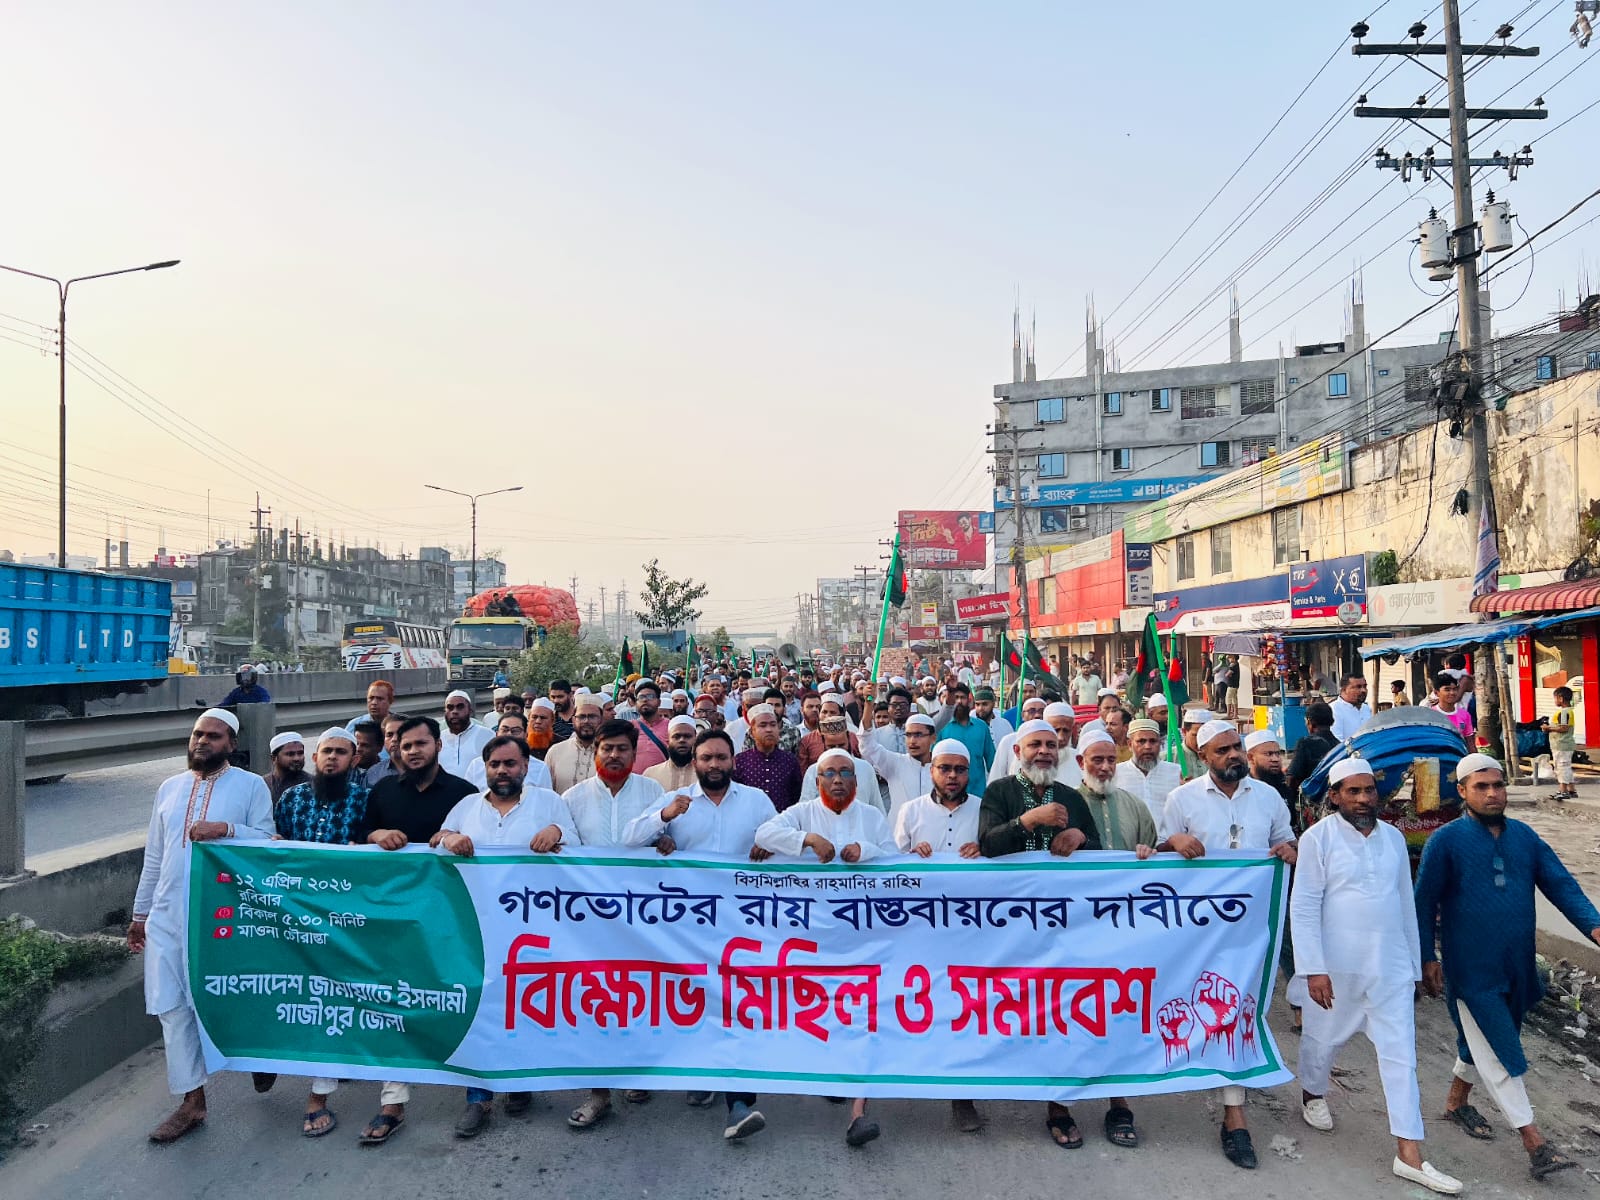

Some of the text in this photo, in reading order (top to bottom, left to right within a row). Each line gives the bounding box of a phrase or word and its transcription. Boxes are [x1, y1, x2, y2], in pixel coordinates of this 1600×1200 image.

[1129, 550, 1150, 558] TVS
[1293, 570, 1306, 580] TVS
[78, 629, 134, 649] LTD
[236, 871, 352, 893] ১২ এপ্রিল ২০২৬
[881, 873, 922, 889] রাহিম
[239, 888, 284, 907] রবিবার
[499, 881, 1253, 931] গণভোটের রায় বাস্তবায়নের দাবীতে
[238, 902, 367, 929] বিকাল ৫.৩০ মিনিট
[237, 924, 329, 945] মাওনা চৌরাস্তা
[204, 974, 468, 1015] বাংলাদেশ জামায়াতে ইসলামী
[502, 933, 1157, 1042] বিক্ষোভ মিছিল ও সমাবেশ
[275, 996, 406, 1037] গাজীপুর জেলা
